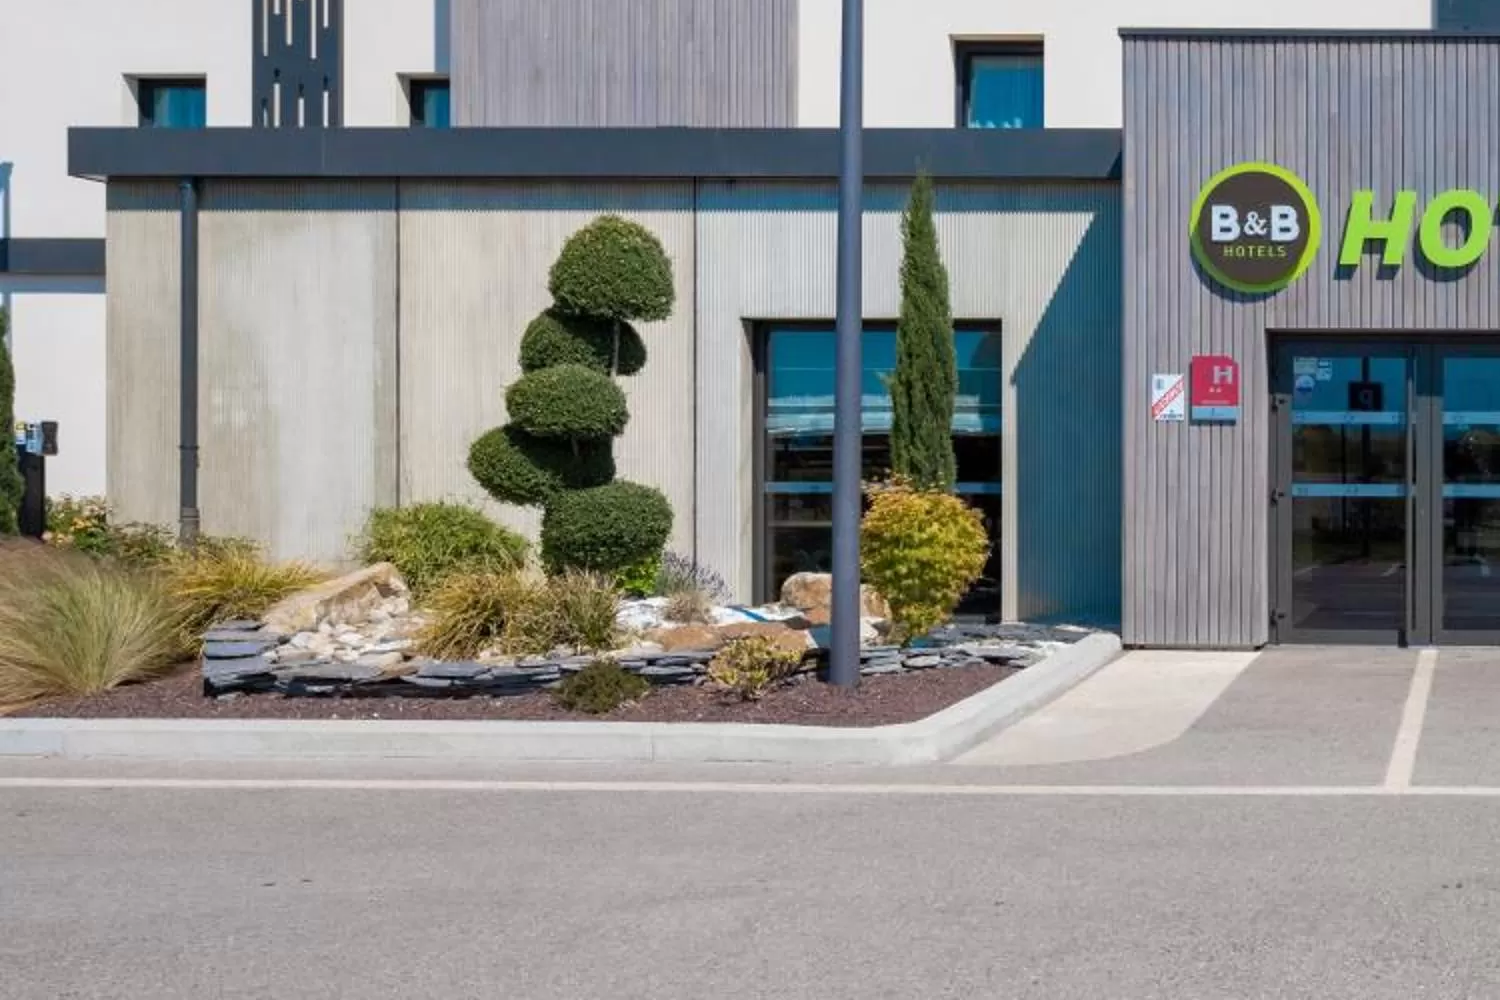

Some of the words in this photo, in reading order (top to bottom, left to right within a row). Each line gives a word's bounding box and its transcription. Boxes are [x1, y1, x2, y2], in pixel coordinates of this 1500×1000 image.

[1211, 205, 1300, 241] B&B
[1223, 245, 1287, 257] HOTELS
[1213, 366, 1233, 384] H
